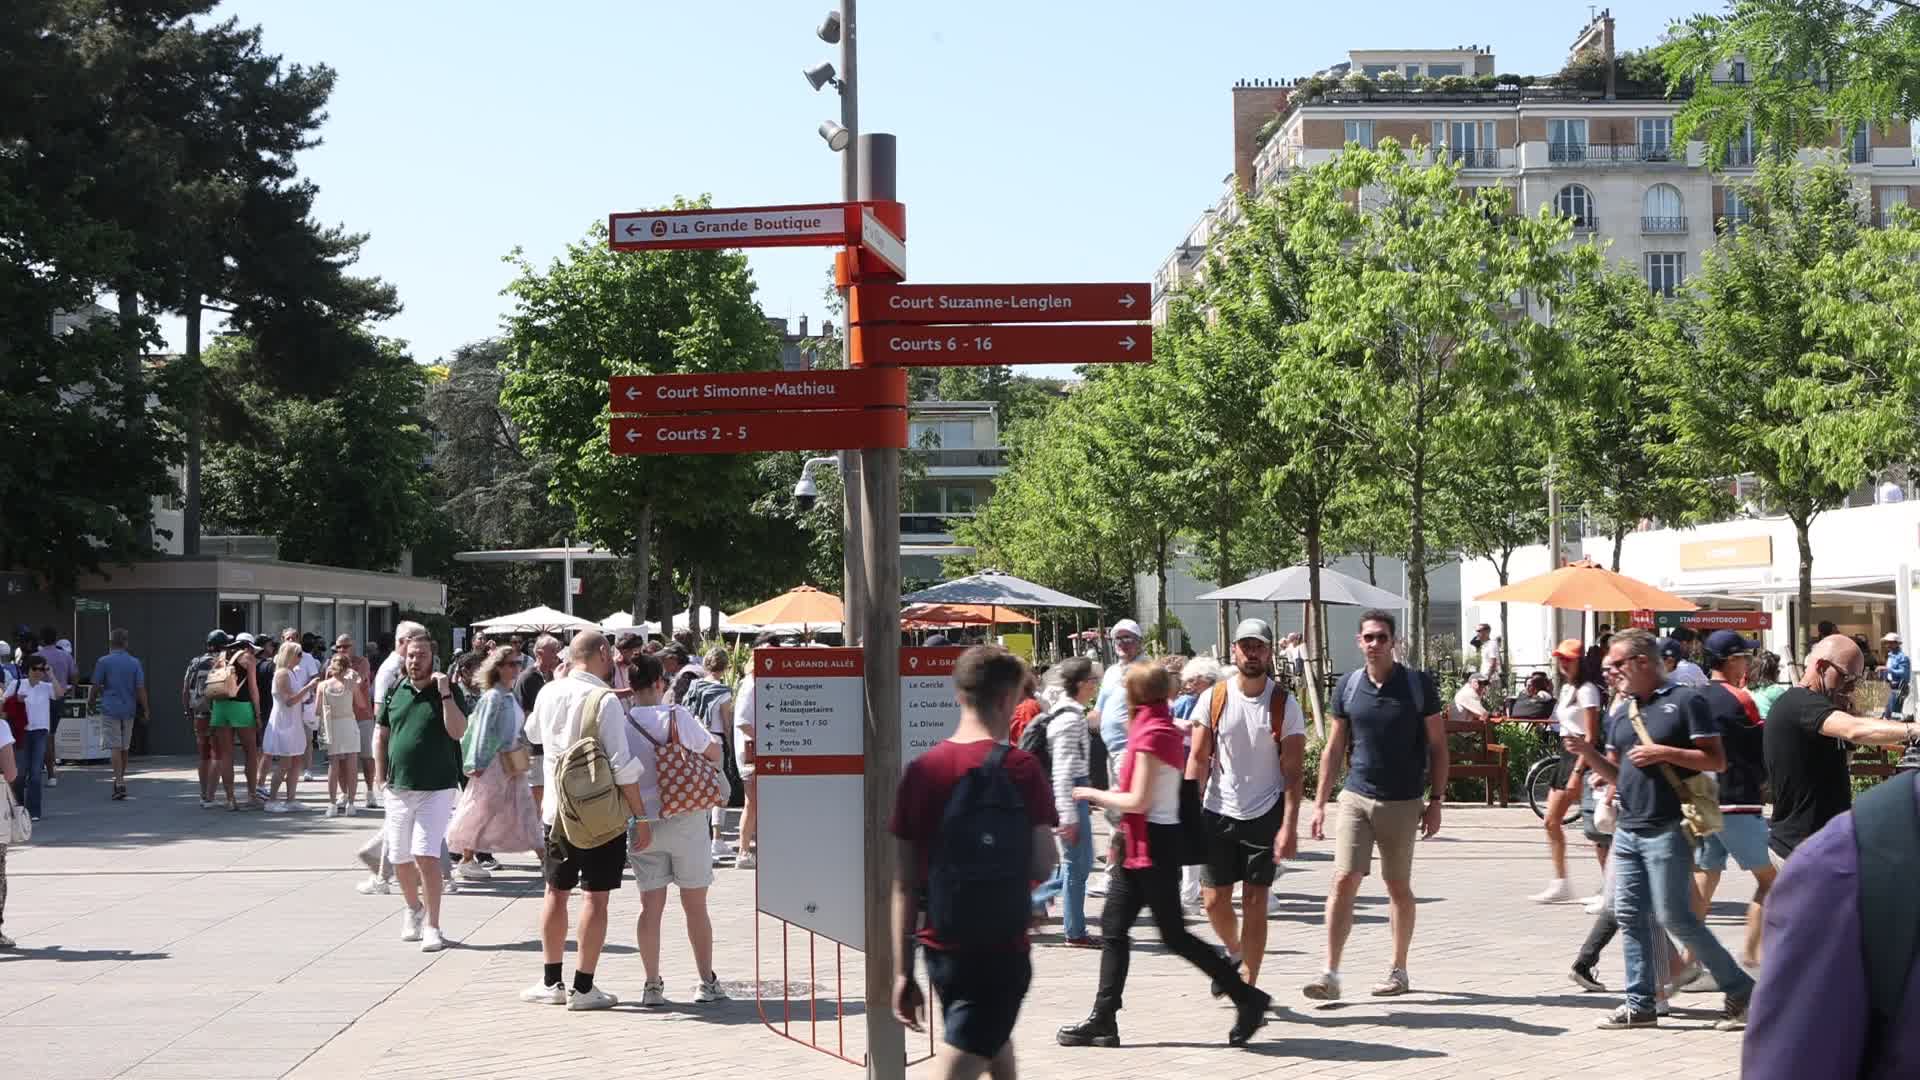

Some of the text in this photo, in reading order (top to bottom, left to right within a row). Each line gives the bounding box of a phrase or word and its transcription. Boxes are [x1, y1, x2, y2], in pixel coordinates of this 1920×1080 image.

[672, 216, 821, 234] La Grande Boutique
[889, 294, 1072, 311] Court Suzanne-Lenglen
[889, 337, 942, 351] Courts
[946, 337, 957, 350] 6
[974, 336, 992, 350] 16
[656, 382, 835, 399] Court Simonne-Mathieu
[656, 427, 706, 441] Courts
[711, 426, 721, 440] 2
[738, 426, 747, 440] 5
[1679, 616, 1701, 624] STAND
[782, 660, 792, 668] LA
[794, 660, 828, 668] GRANDE
[927, 659, 937, 667] LA
[920, 681, 944, 689] Cercle
[780, 706, 833, 714] Mousquetaires
